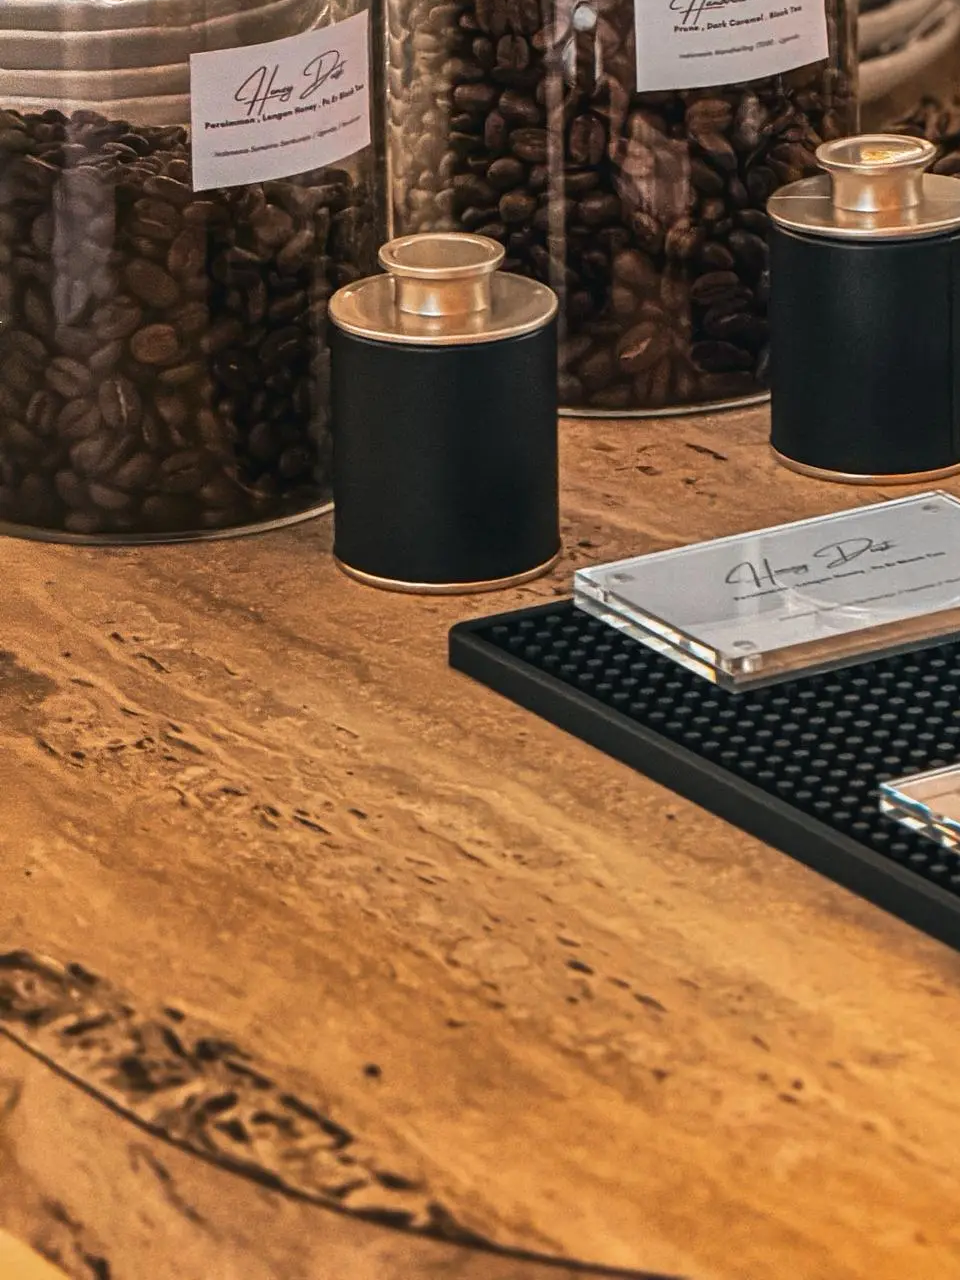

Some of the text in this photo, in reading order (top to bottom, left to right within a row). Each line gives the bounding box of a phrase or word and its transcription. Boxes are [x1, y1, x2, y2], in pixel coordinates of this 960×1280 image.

[707, 20, 727, 30] Dark
[729, 13, 764, 27] Caramel
[235, 64, 293, 116] Honey
